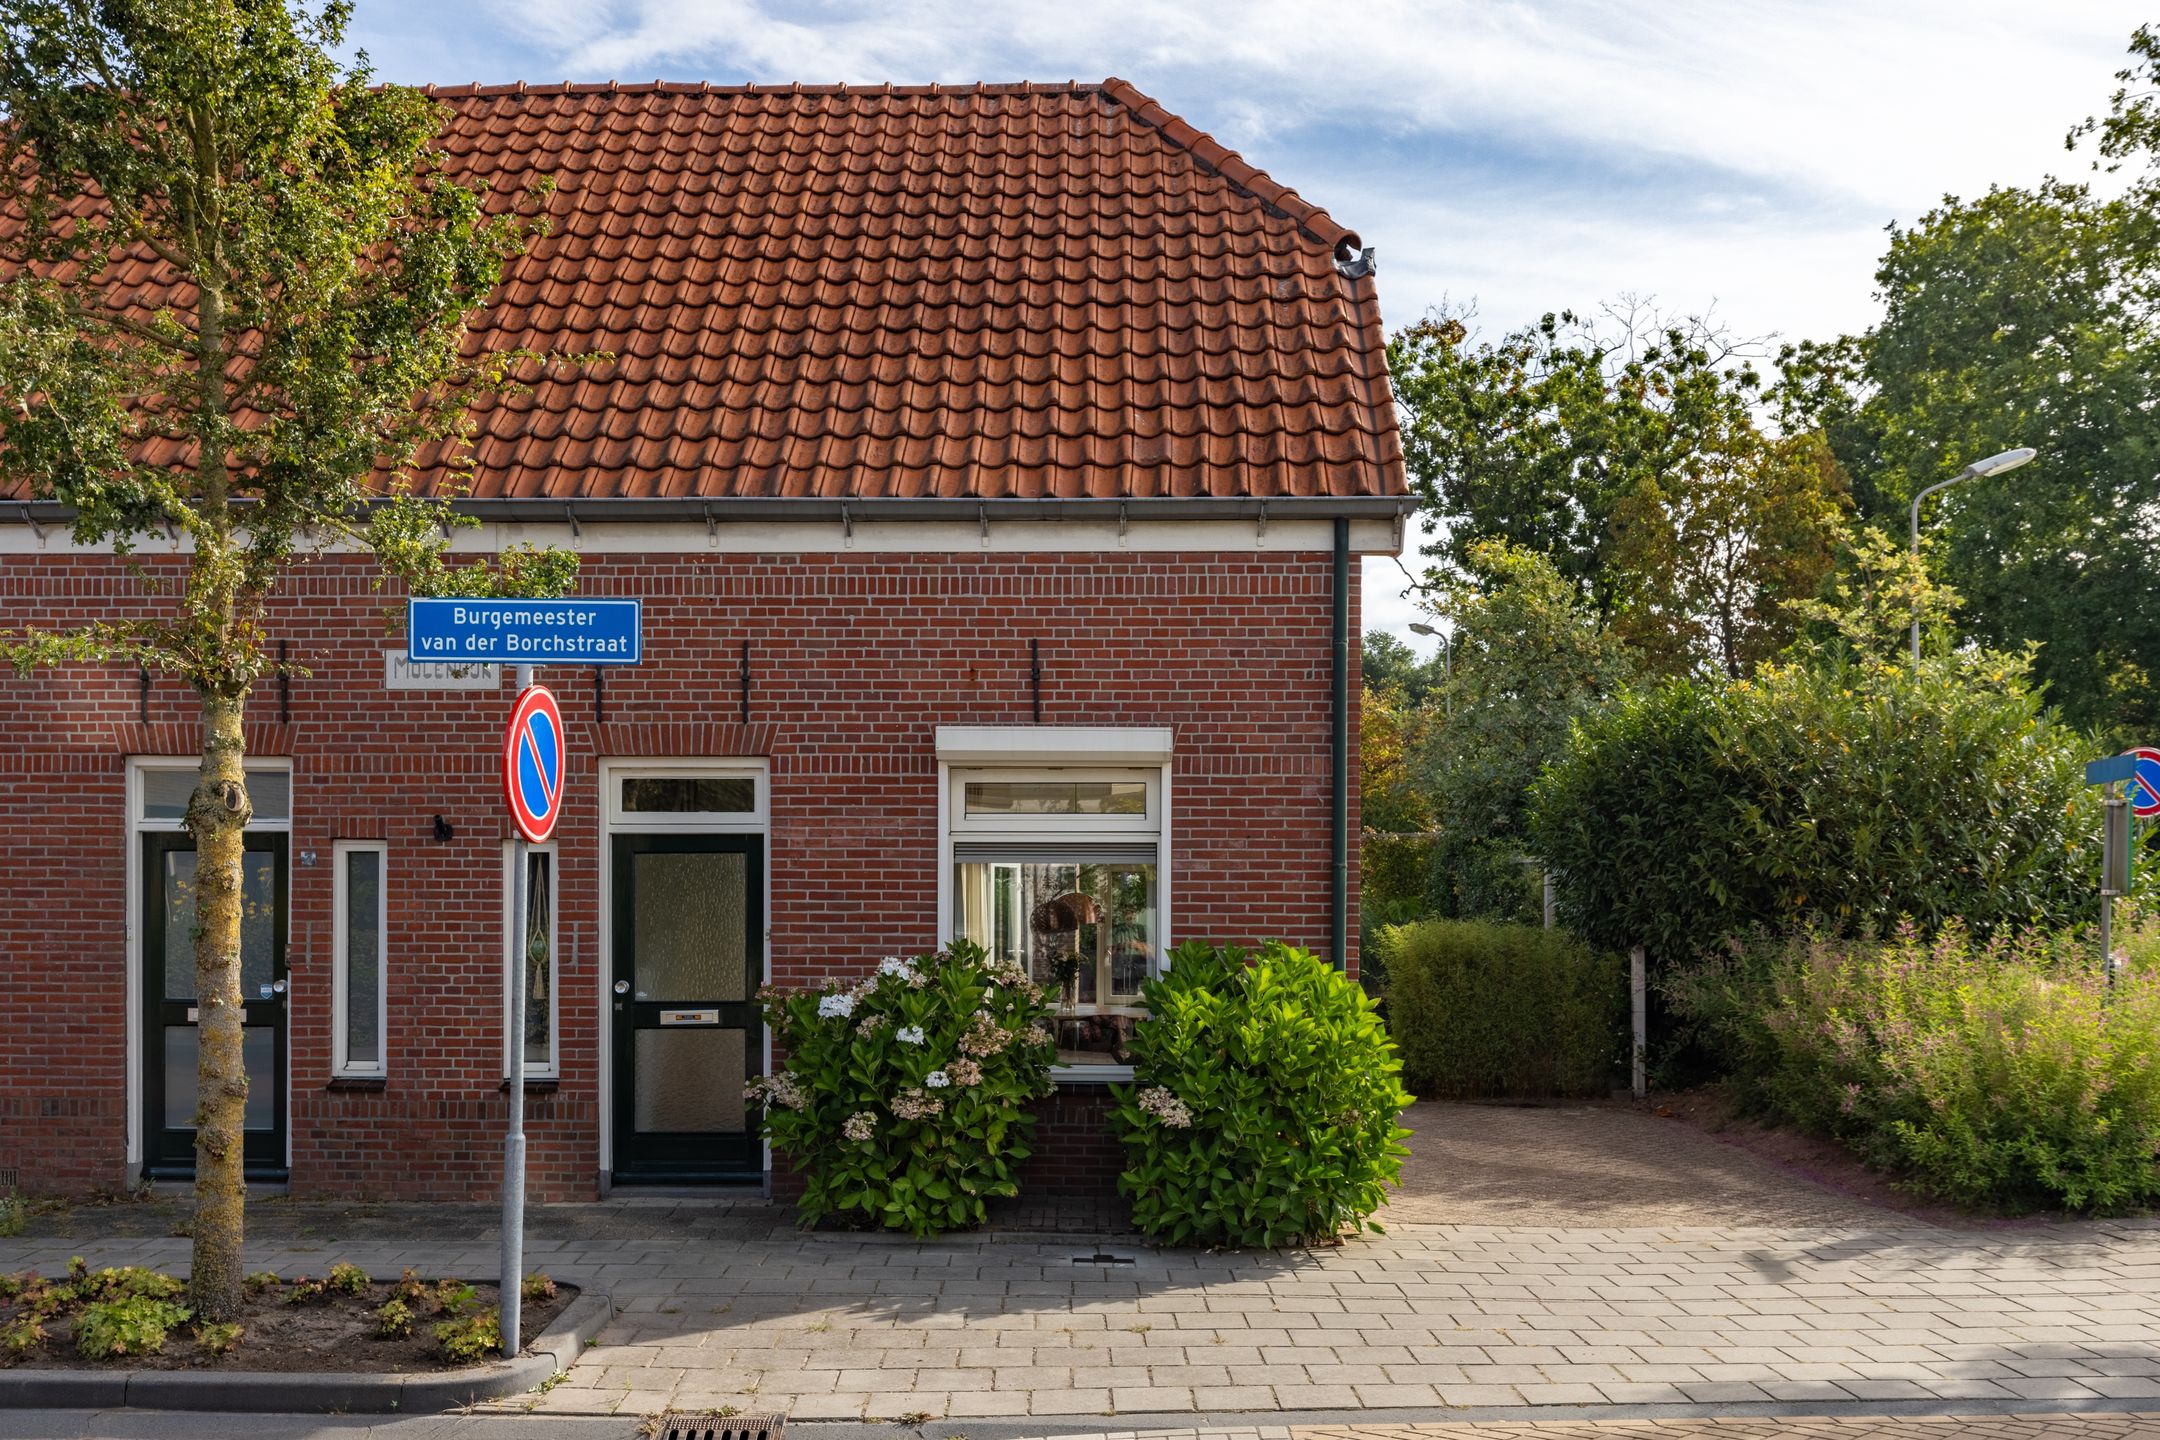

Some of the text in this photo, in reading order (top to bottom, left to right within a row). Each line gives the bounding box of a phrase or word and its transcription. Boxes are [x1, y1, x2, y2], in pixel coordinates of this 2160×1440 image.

[454, 607, 597, 630] Burgemeester
[421, 633, 628, 653] van der Borchstraat
